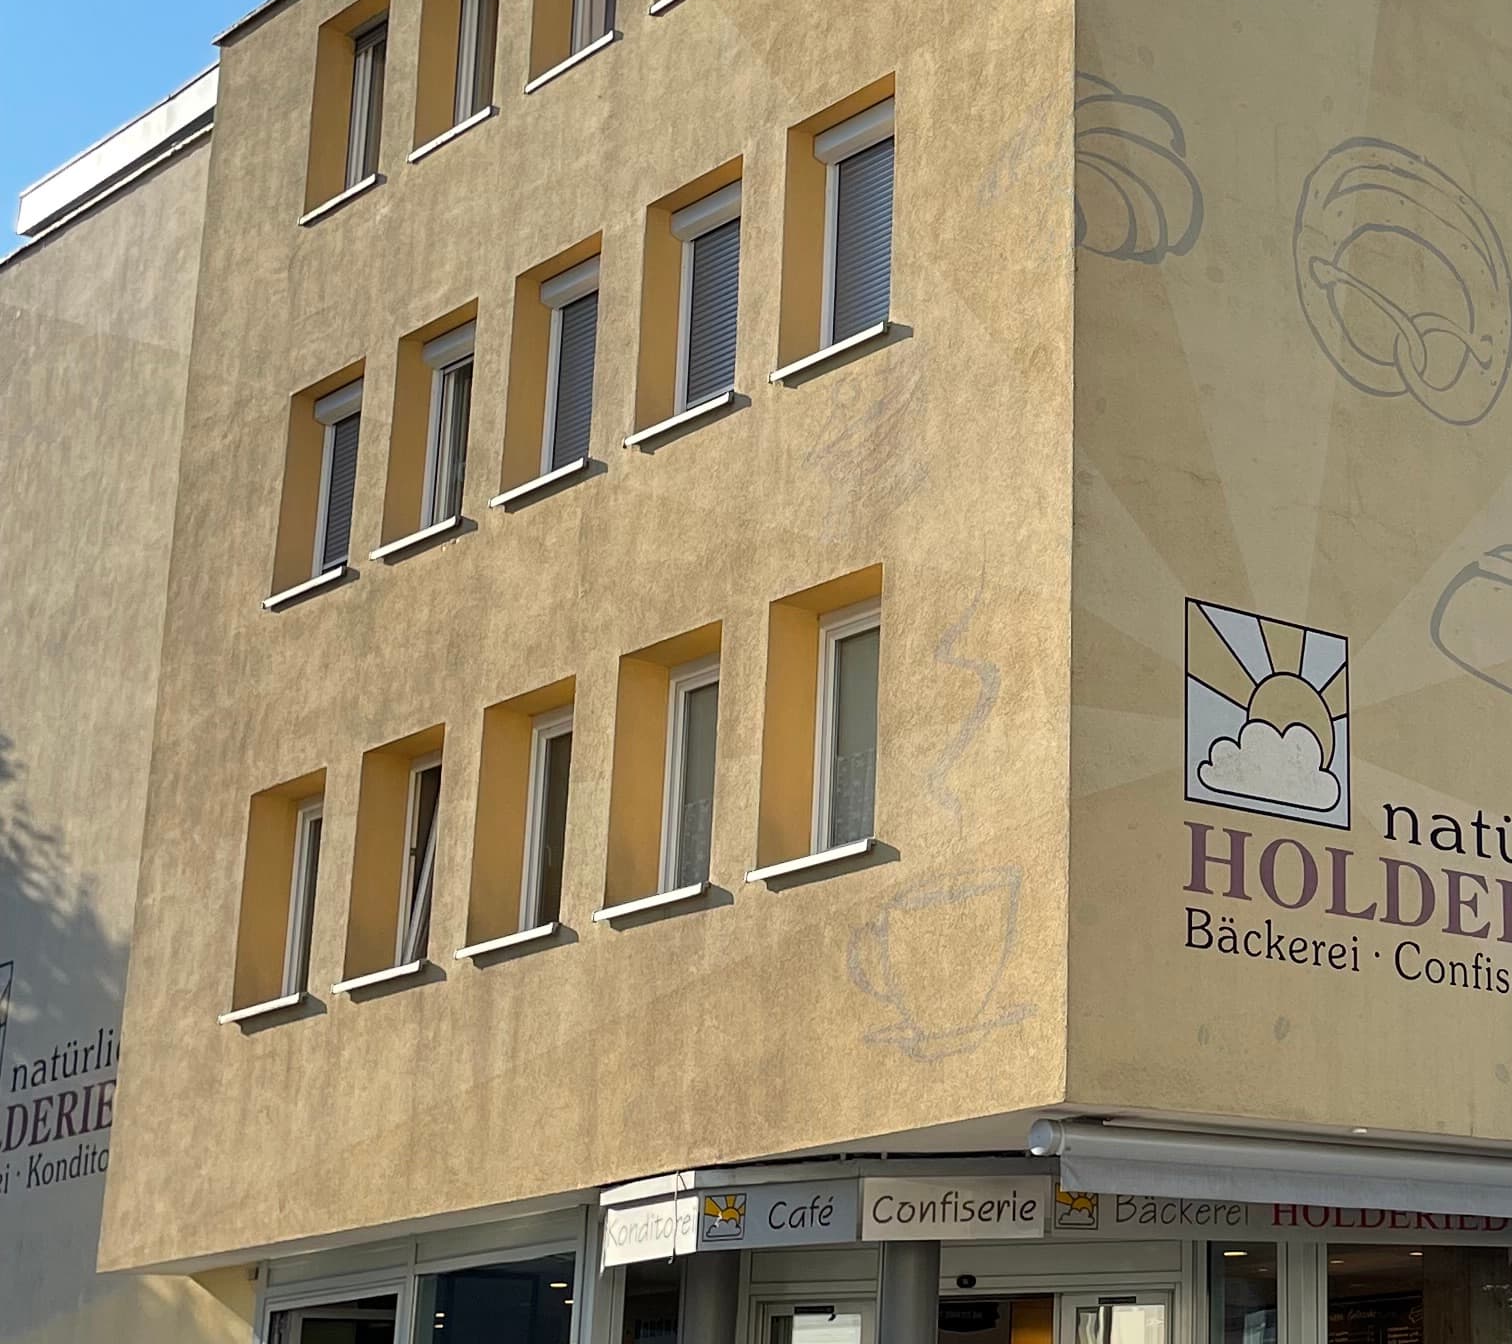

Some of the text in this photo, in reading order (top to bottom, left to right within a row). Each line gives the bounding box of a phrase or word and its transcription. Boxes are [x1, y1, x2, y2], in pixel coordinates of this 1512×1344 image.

[1185, 907, 1360, 972] Bäckerei
[768, 1195, 833, 1229] Café
[872, 1190, 1037, 1223] Confiserie
[606, 1207, 696, 1246] Konditorei
